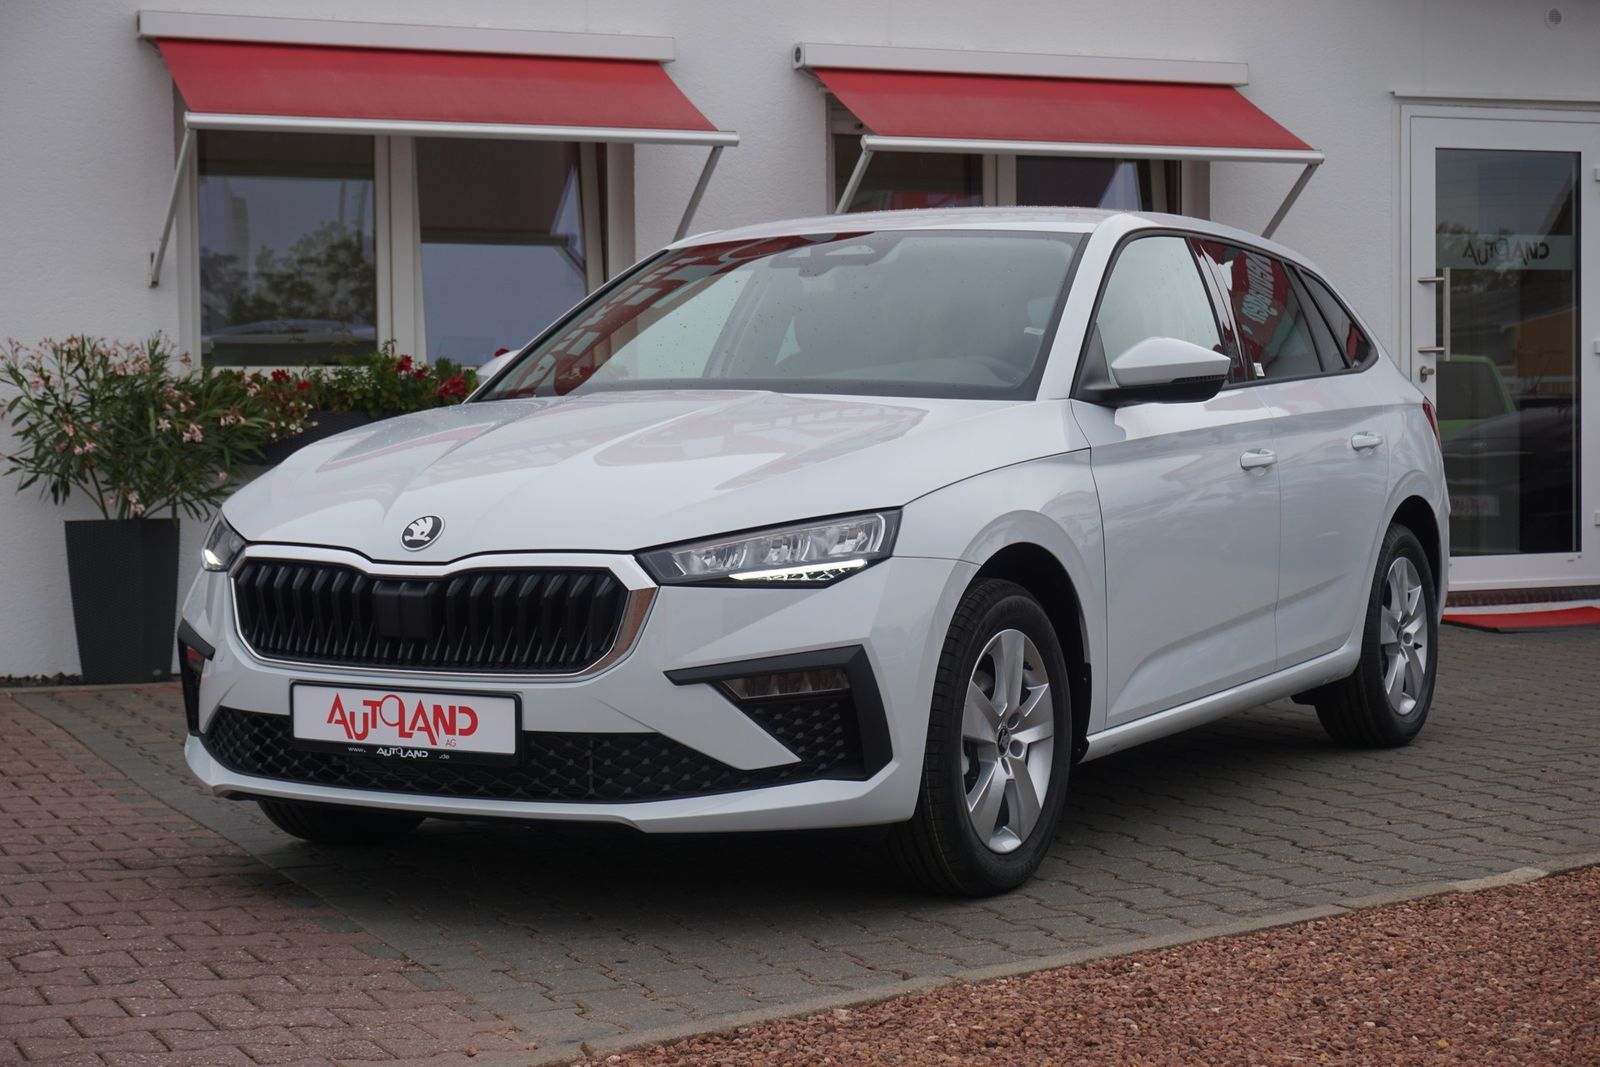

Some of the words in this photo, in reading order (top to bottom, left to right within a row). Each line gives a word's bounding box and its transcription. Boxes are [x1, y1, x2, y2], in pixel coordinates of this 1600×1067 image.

[327, 692, 479, 746] AUTOLAND
[445, 738, 457, 747] AG
[376, 746, 429, 759] AUTOLAND
